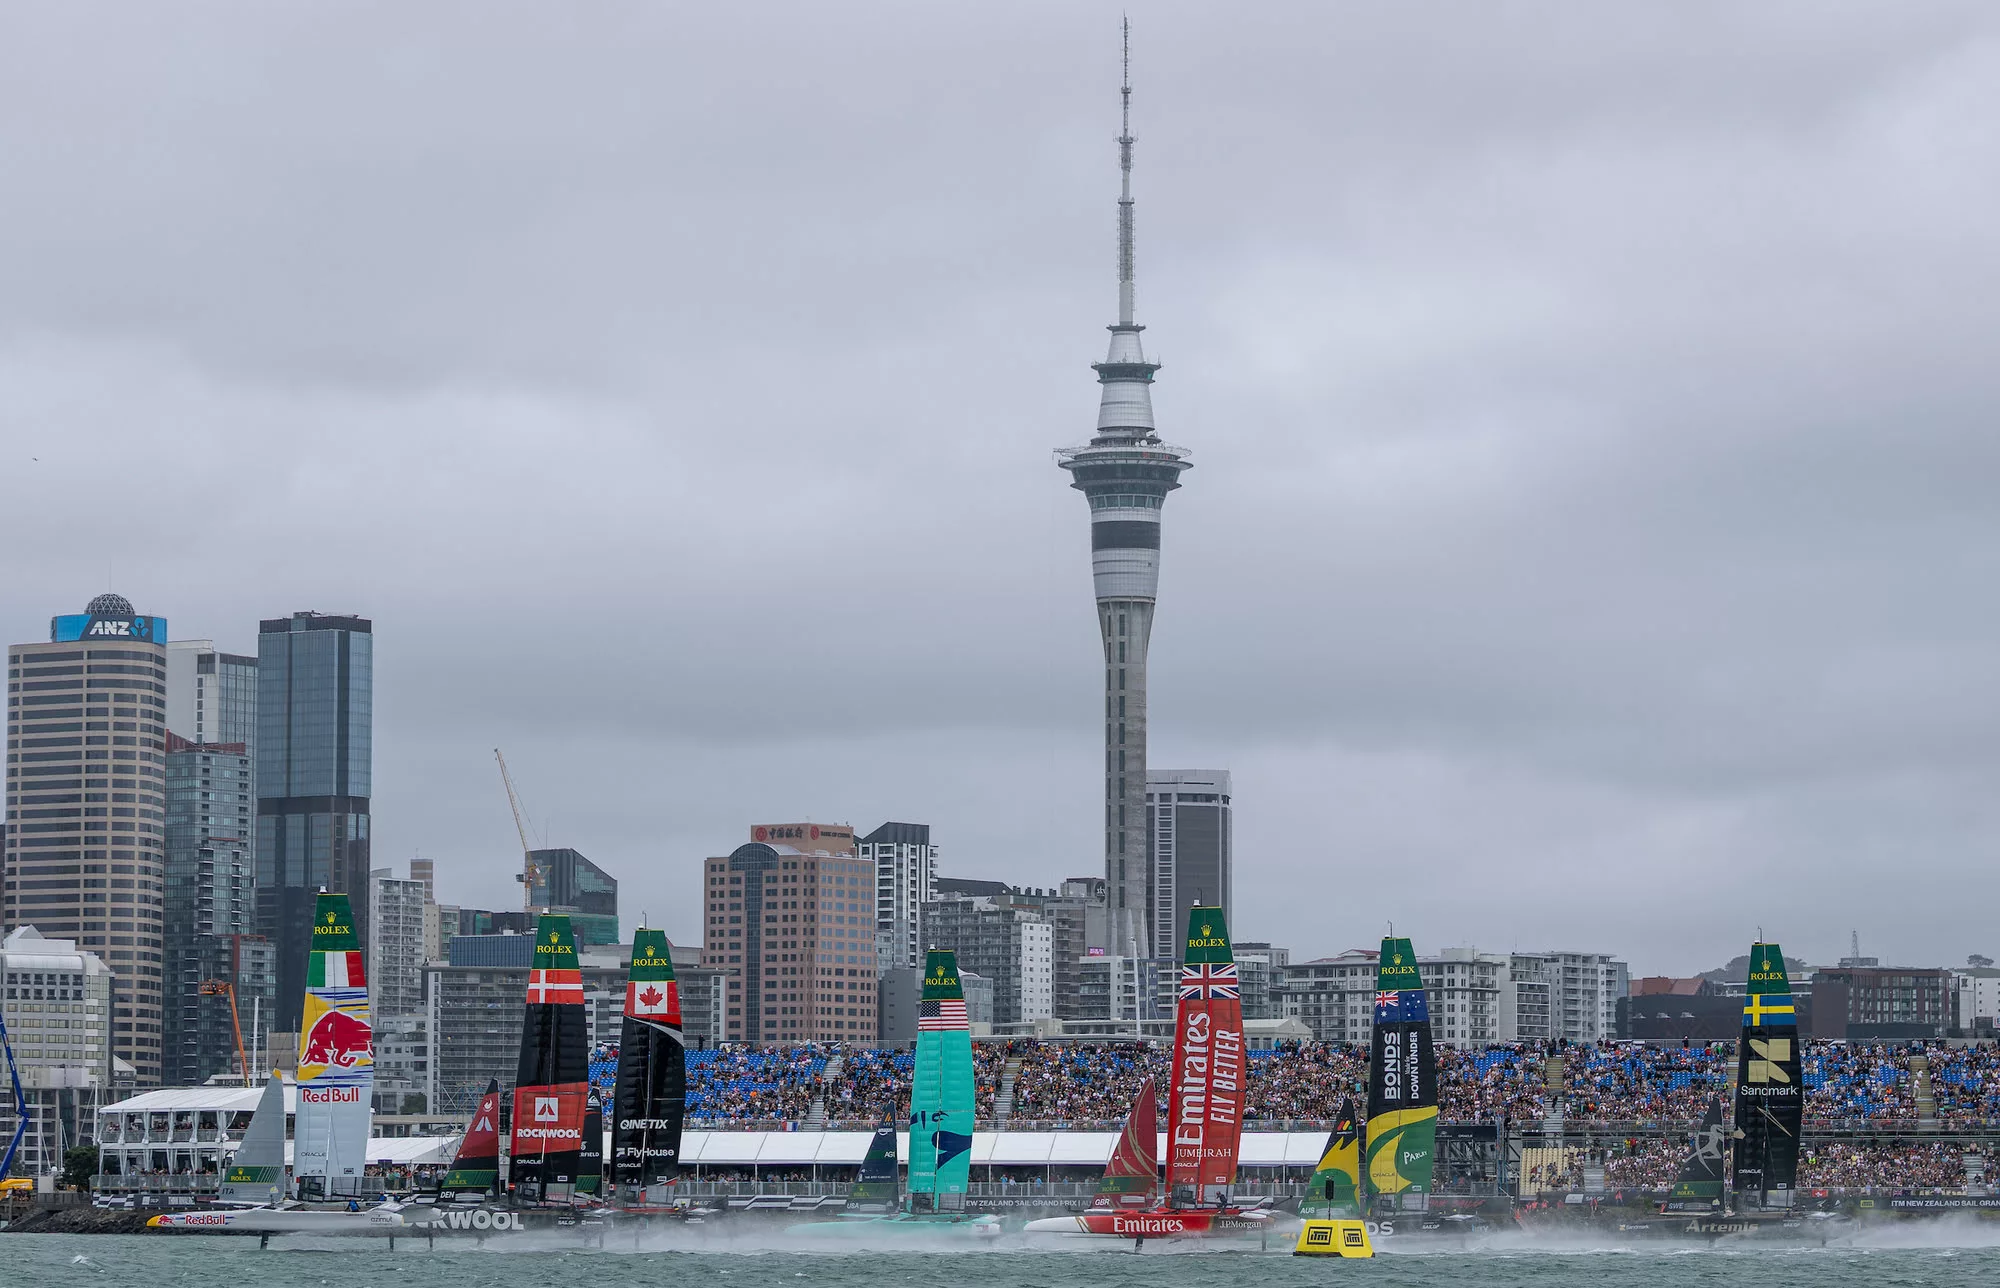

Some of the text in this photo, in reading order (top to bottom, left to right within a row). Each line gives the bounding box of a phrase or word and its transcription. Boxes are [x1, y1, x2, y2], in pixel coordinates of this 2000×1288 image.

[89, 621, 130, 635] ANZ
[313, 926, 350, 934] ROLEX
[1188, 938, 1226, 948] ROLEX
[537, 945, 573, 954] ROLEX
[633, 958, 668, 967] ROLEX
[1381, 966, 1416, 975] ROLEX
[1750, 972, 1783, 980] ROLEX
[925, 977, 957, 986] ROLEX
[1384, 1032, 1397, 1100] BONDS
[1410, 1031, 1419, 1100] DOWN UNDER
[1174, 1012, 1211, 1146] Emirates
[1210, 1029, 1240, 1124] FLY BETTER
[302, 1087, 359, 1102] Red Bull
[1740, 1085, 1798, 1096] Sandmark
[516, 1128, 580, 1139] ROCKWOOL
[627, 1147, 675, 1157] FlyHouse
[1174, 1148, 1232, 1159] JUMEIRAH
[222, 1187, 234, 1195] ITA
[440, 1191, 455, 1199] DEN
[1095, 1198, 1110, 1206] GBR
[185, 1214, 225, 1225] Red Bull
[1114, 1217, 1183, 1232] Emirates
[1686, 1220, 1759, 1233] Artemis
